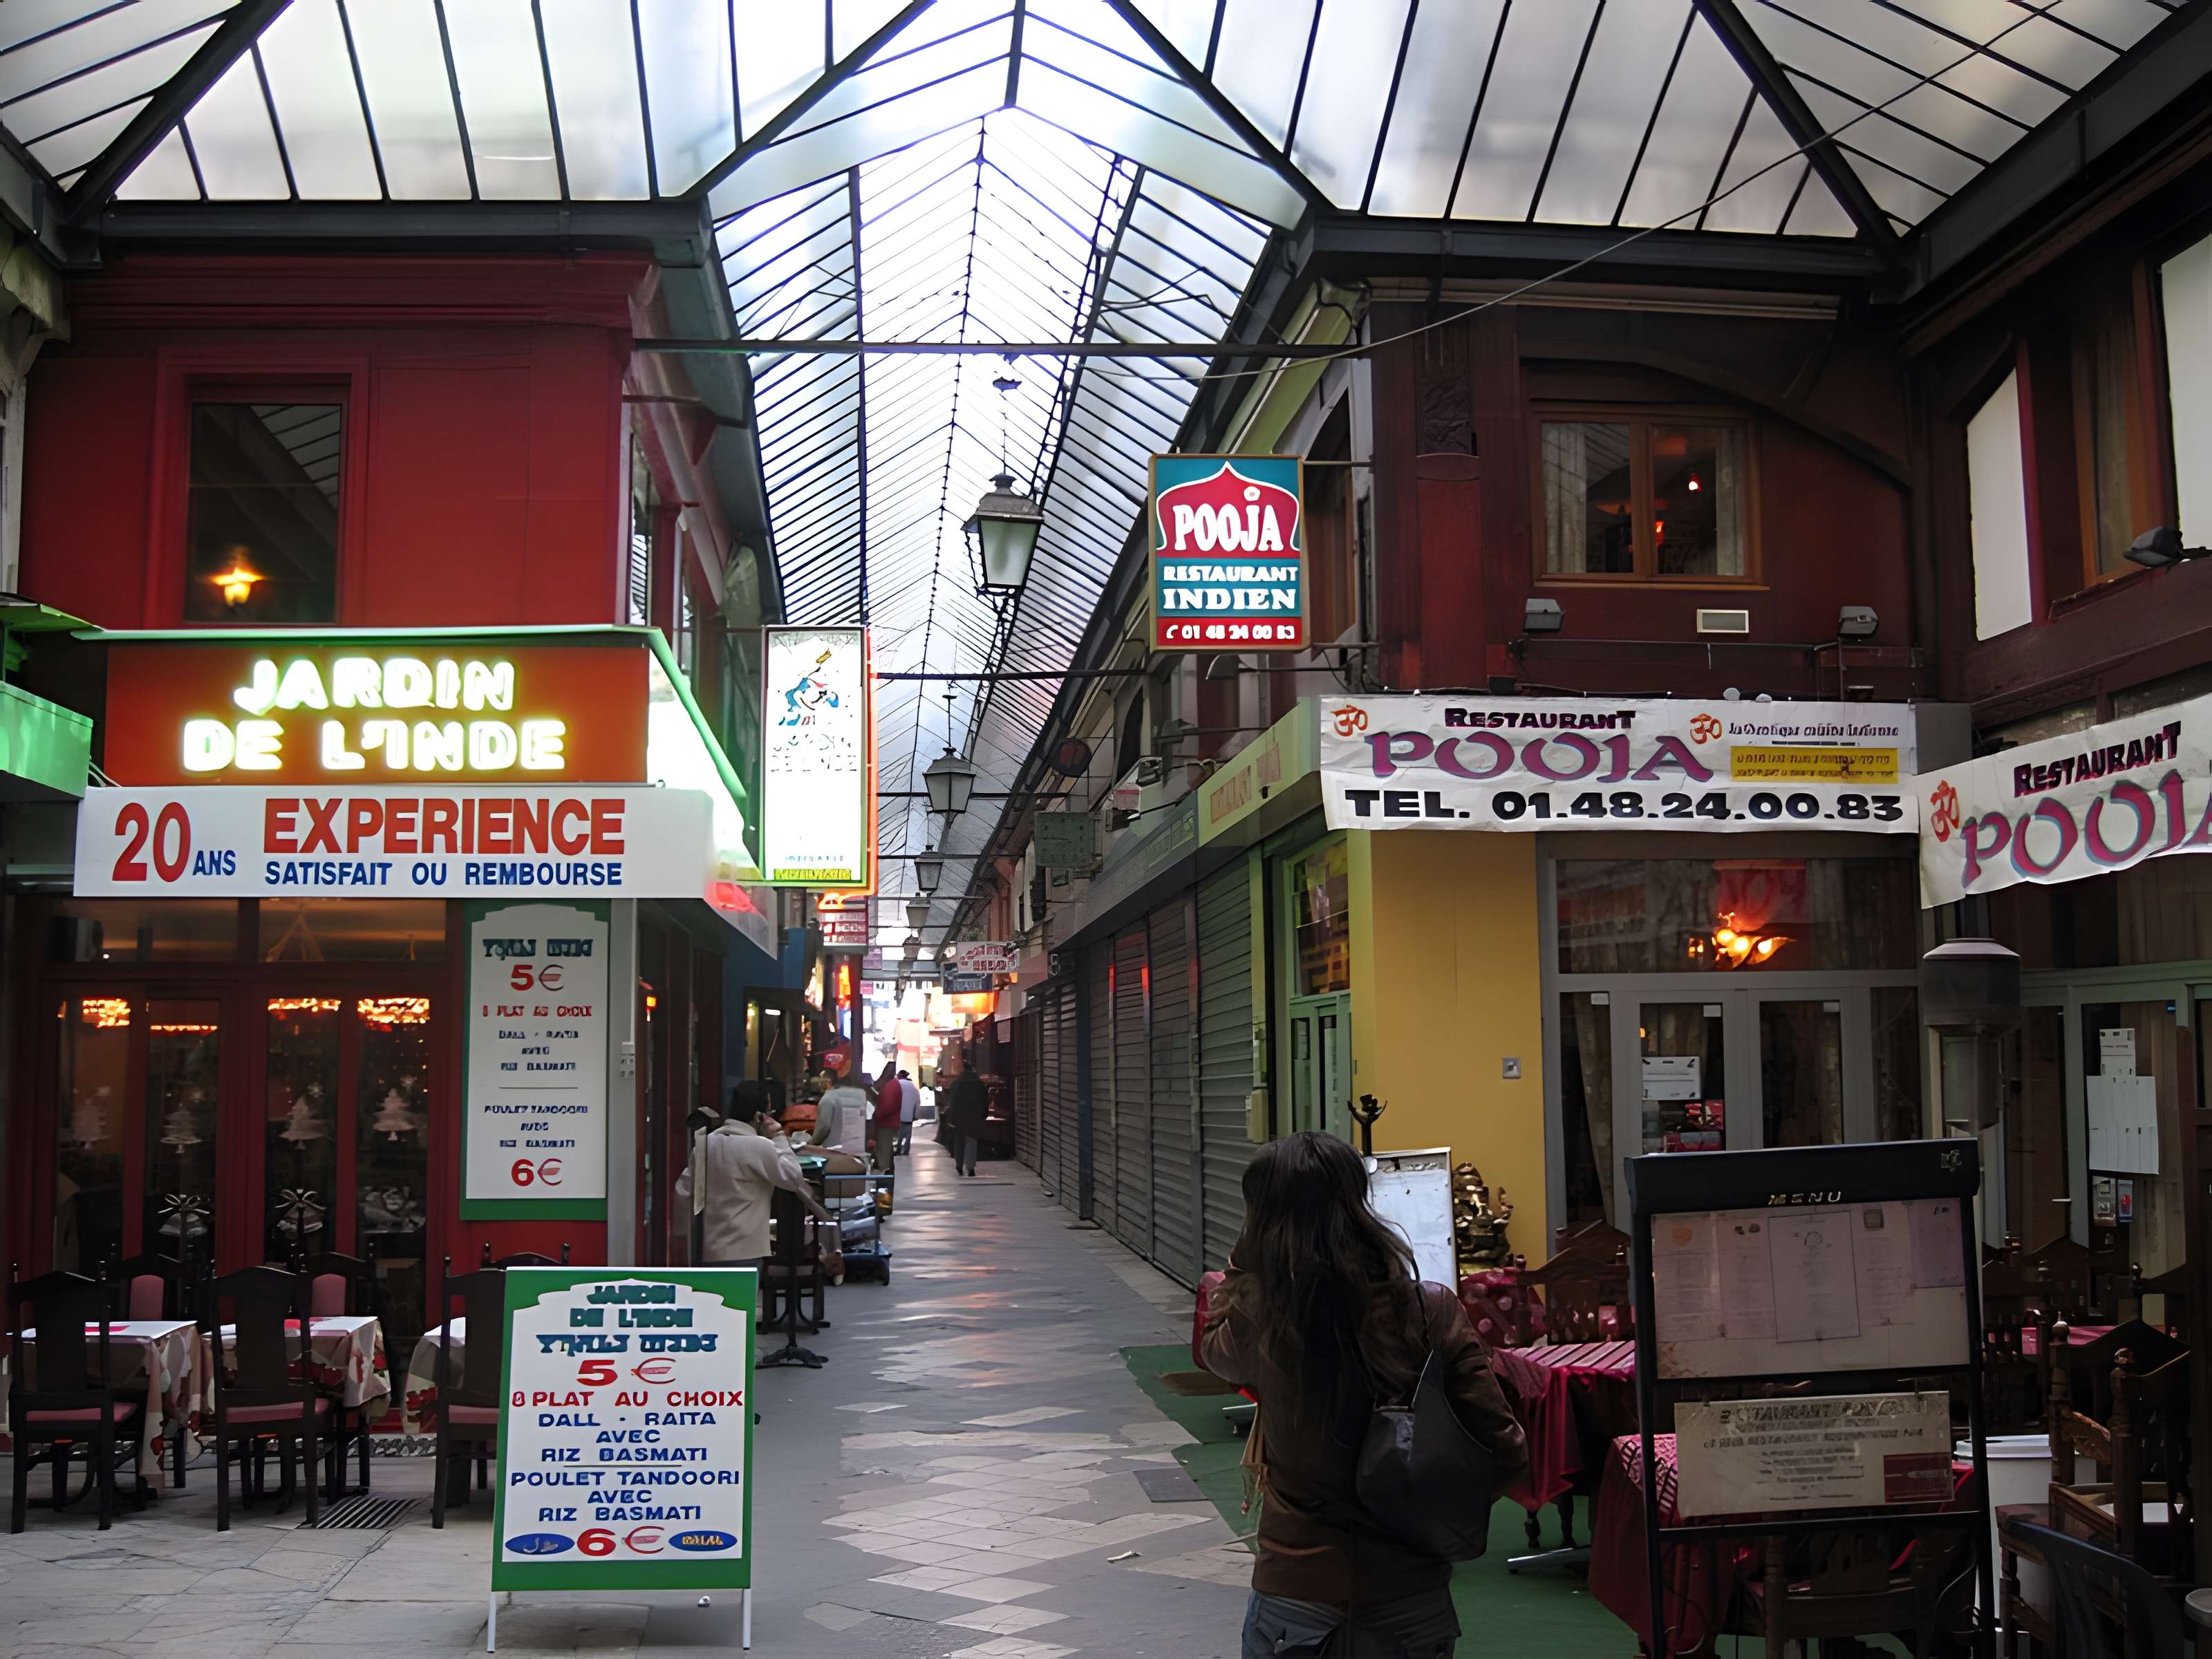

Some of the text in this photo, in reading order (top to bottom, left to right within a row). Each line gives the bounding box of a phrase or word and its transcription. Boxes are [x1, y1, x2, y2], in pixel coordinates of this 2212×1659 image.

[1163, 565, 1298, 581] RESTAURANT
[1163, 588, 1296, 610] INDIEN
[233, 657, 514, 715] JARDIN
[1445, 707, 1636, 730] RESTAURANT
[182, 720, 567, 771] DE L'INDE
[1365, 730, 1714, 782] POOJA
[2014, 720, 2182, 798] RESTAURANT
[1344, 789, 1904, 821] TEL. 01.48.24.00.83
[263, 798, 626, 856] EXPERIENCE
[112, 801, 236, 882] 20 ANS
[265, 861, 623, 886] SATISFAIT OU REMBOURSE
[532, 1391, 594, 1407] PLAT
[615, 1391, 648, 1407] AU
[666, 1390, 744, 1407] CHOIX
[538, 1412, 716, 1427] DALL RAITA
[596, 1430, 661, 1443] AVEC
[541, 1447, 708, 1462] RIZ BASMATI
[511, 1470, 740, 1486] POULET TANDOORI
[587, 1490, 652, 1504] AVEC
[539, 1506, 702, 1521] RIZ BASMATI
